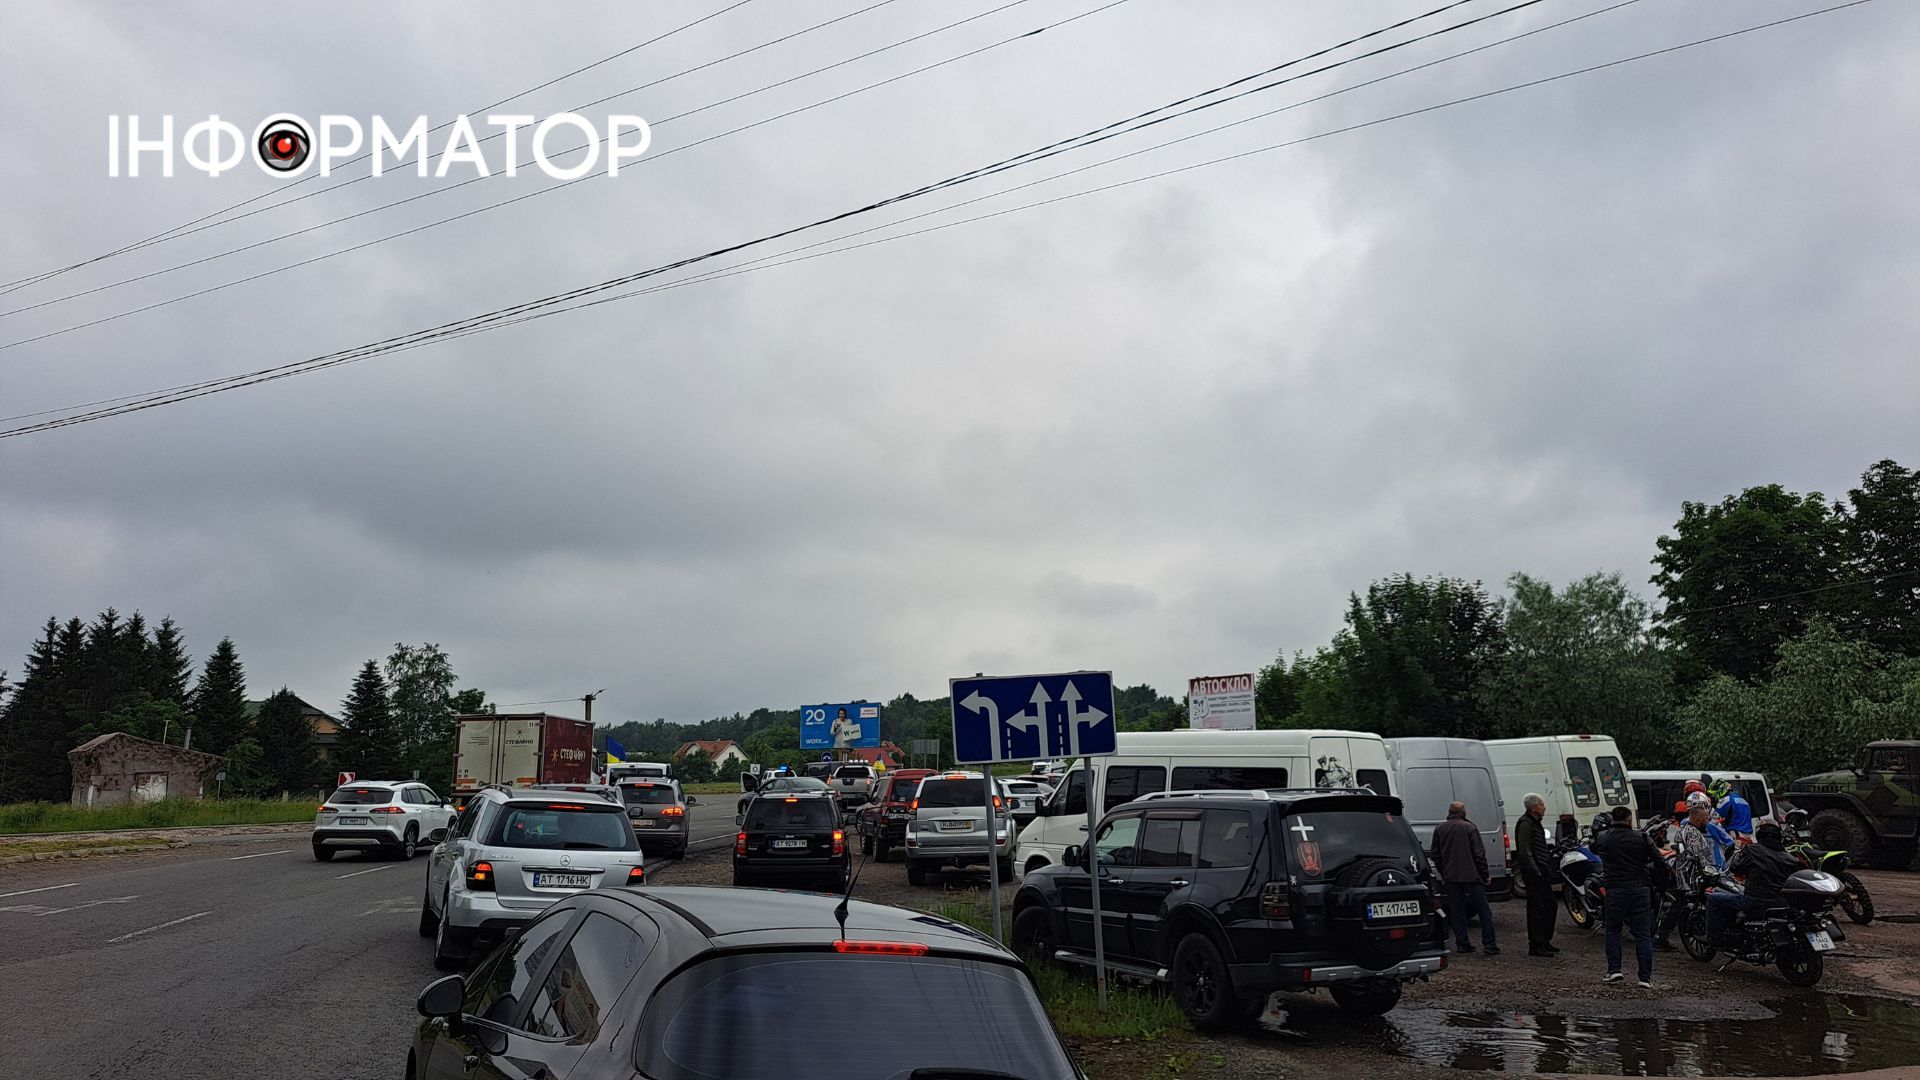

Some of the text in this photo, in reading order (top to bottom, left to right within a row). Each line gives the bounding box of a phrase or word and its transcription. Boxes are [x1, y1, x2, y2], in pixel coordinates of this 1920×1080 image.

[1193, 676, 1249, 695] АВТОСКЛО
[805, 709, 825, 722] 20
[540, 875, 589, 884] AT 1716 HK
[1373, 902, 1419, 916] AT 4174 HB
